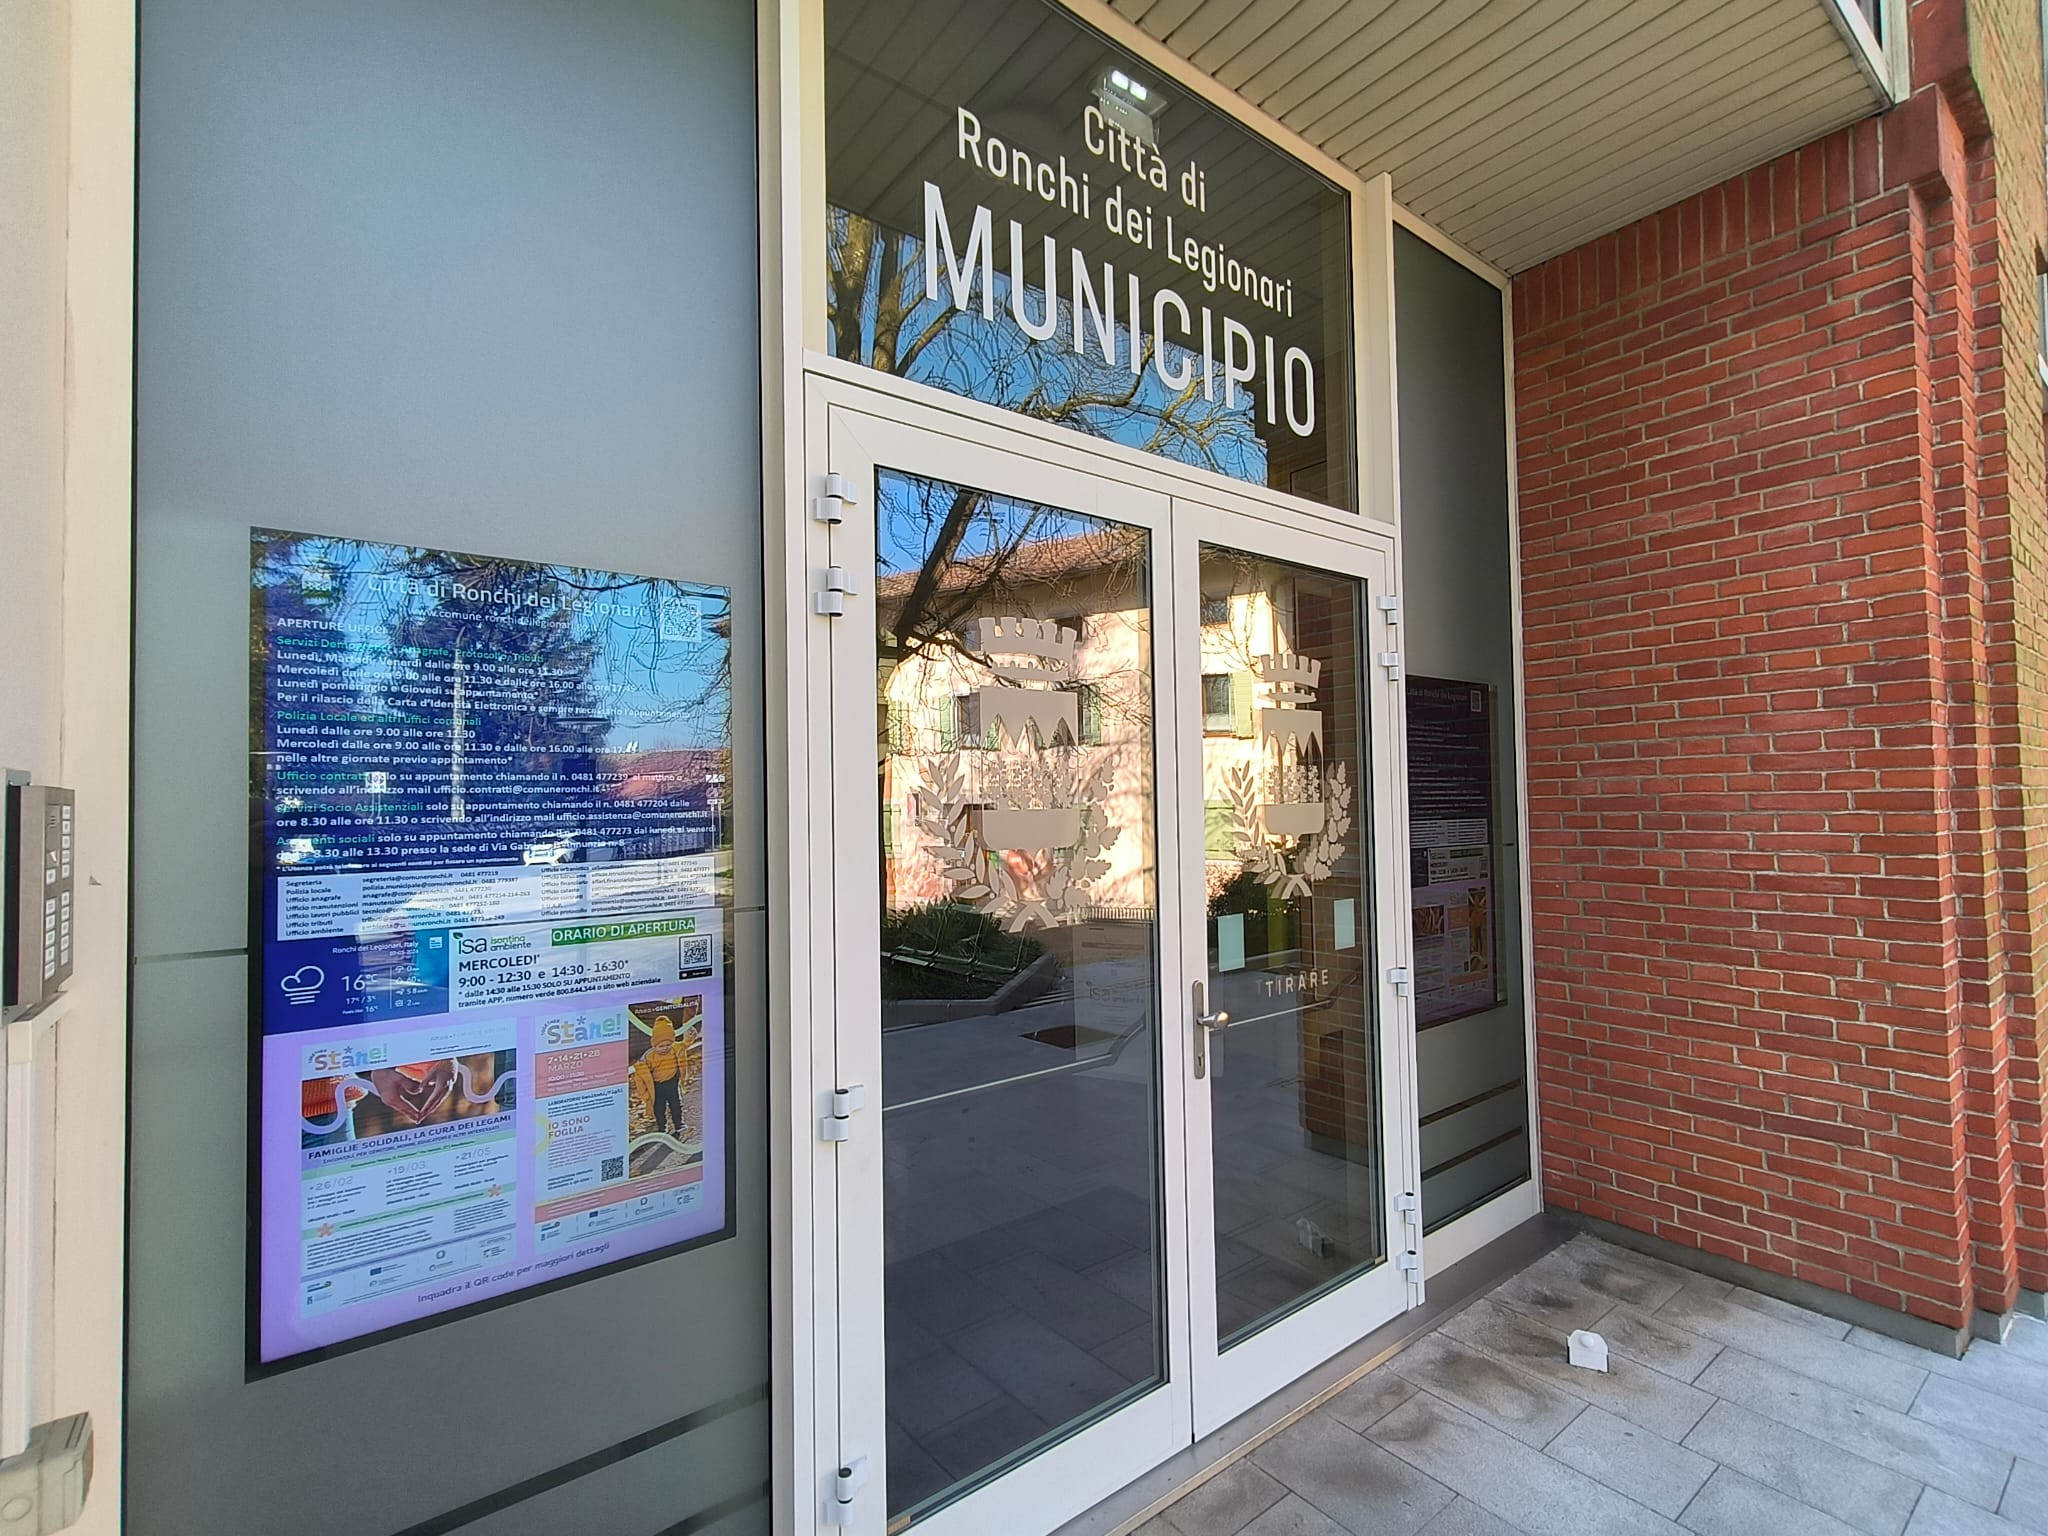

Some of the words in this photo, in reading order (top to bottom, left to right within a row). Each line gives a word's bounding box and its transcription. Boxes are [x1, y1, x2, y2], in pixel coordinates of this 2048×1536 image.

[1084, 105, 1168, 192] Città
[1181, 161, 1206, 212] di
[957, 107, 1090, 218] Ronchi
[1105, 185, 1153, 250] dei
[1166, 216, 1293, 317] Legionari
[924, 180, 1316, 437] MUNICIPIO
[366, 573, 419, 595] Città
[427, 580, 444, 597] di
[452, 583, 520, 605] Ronchi
[527, 591, 555, 608] dei
[562, 595, 643, 617] Legionari
[277, 617, 344, 631] APERTURE
[347, 623, 387, 634] UFFICI
[276, 636, 317, 647] Servizi
[513, 653, 543, 662] Tributi
[276, 650, 322, 662] Lunedì,
[378, 657, 421, 667] Venerdì
[424, 660, 451, 669] dalle
[473, 663, 495, 671] 9.00
[498, 665, 516, 673] alle
[276, 664, 338, 676] Mercoledì
[421, 673, 441, 681] alle
[464, 675, 492, 684] 11.30
[549, 680, 574, 688] 16.00
[276, 678, 318, 689] Lunedì
[400, 685, 442, 694] Giovedì
[277, 692, 297, 701] Per
[311, 694, 353, 704] rilascio
[387, 697, 416, 706] Carta
[474, 701, 527, 711] Elettronica
[277, 710, 316, 720] Polizia
[320, 711, 357, 721] Locale
[403, 715, 430, 723] uffici
[276, 725, 318, 734] Lunedì
[321, 726, 350, 735] dalle
[375, 727, 399, 736] 9.00
[402, 728, 422, 737] alle
[276, 738, 338, 748] Mercoledì
[341, 740, 370, 748] dalle
[395, 741, 419, 749] 9.00
[421, 742, 441, 750] alle
[464, 743, 492, 751] 11.30
[503, 743, 527, 751] dalle
[548, 744, 574, 752] 16.00
[276, 753, 307, 761] nelle
[310, 753, 338, 762] altre
[341, 754, 389, 764] giornate
[392, 755, 427, 765] previo
[276, 771, 316, 780] Ufficio
[414, 772, 493, 782] appuntamento
[276, 785, 335, 794] scrivendo
[407, 785, 430, 793] mail
[433, 785, 599, 794] ufficio.contratti@comuneronchi.it
[319, 803, 351, 812] Socio
[355, 802, 423, 811] Assistenziali
[425, 802, 448, 810] solo
[465, 801, 540, 811] appuntamento
[300, 817, 327, 826] 8.30
[330, 817, 351, 825] alle
[377, 815, 408, 824] 11.30
[420, 814, 472, 823] scrivendo
[474, 814, 531, 822] all'indirizzo
[533, 813, 554, 821] mail
[338, 834, 374, 843] sociali
[377, 834, 401, 842] solo
[419, 831, 497, 843] appuntamento
[342, 848, 363, 856] alle
[366, 846, 398, 856] 13.30
[401, 847, 436, 856] presso
[451, 844, 476, 852] sede
[491, 843, 506, 851] Via
[552, 926, 606, 942] ORARIO
[610, 924, 623, 937] DI
[627, 918, 695, 935] APERTURA
[332, 945, 356, 953] Ronchi
[453, 929, 487, 955] isa
[458, 975, 486, 988] 9:00
[497, 970, 531, 983] 12:30
[537, 971, 546, 979] e
[552, 964, 584, 977] 14:30
[464, 990, 484, 998] dalle
[542, 980, 561, 988] SOLO
[574, 972, 630, 985] APPUNTAMENTO
[1265, 968, 1329, 998] TIRARE
[458, 998, 486, 1007] tramite
[505, 993, 533, 1001] numero
[535, 990, 554, 998] verde
[631, 977, 661, 986] aziendale
[547, 1060, 583, 1073] MARZO
[561, 1114, 590, 1127] SONO
[308, 1143, 357, 1159] FAMIGLIE
[361, 1133, 411, 1149] SOLIDALI,
[428, 1125, 455, 1136] CURA
[457, 1121, 473, 1131] DEI
[476, 1114, 511, 1127] LEGAMI
[548, 1124, 583, 1139] FOGLIA
[418, 1285, 462, 1302] Inquadra
[473, 1275, 489, 1287] QR
[491, 1270, 514, 1282] code
[517, 1266, 531, 1277] per
[534, 1252, 574, 1270] maggiori
[576, 1242, 610, 1258] dettagli
